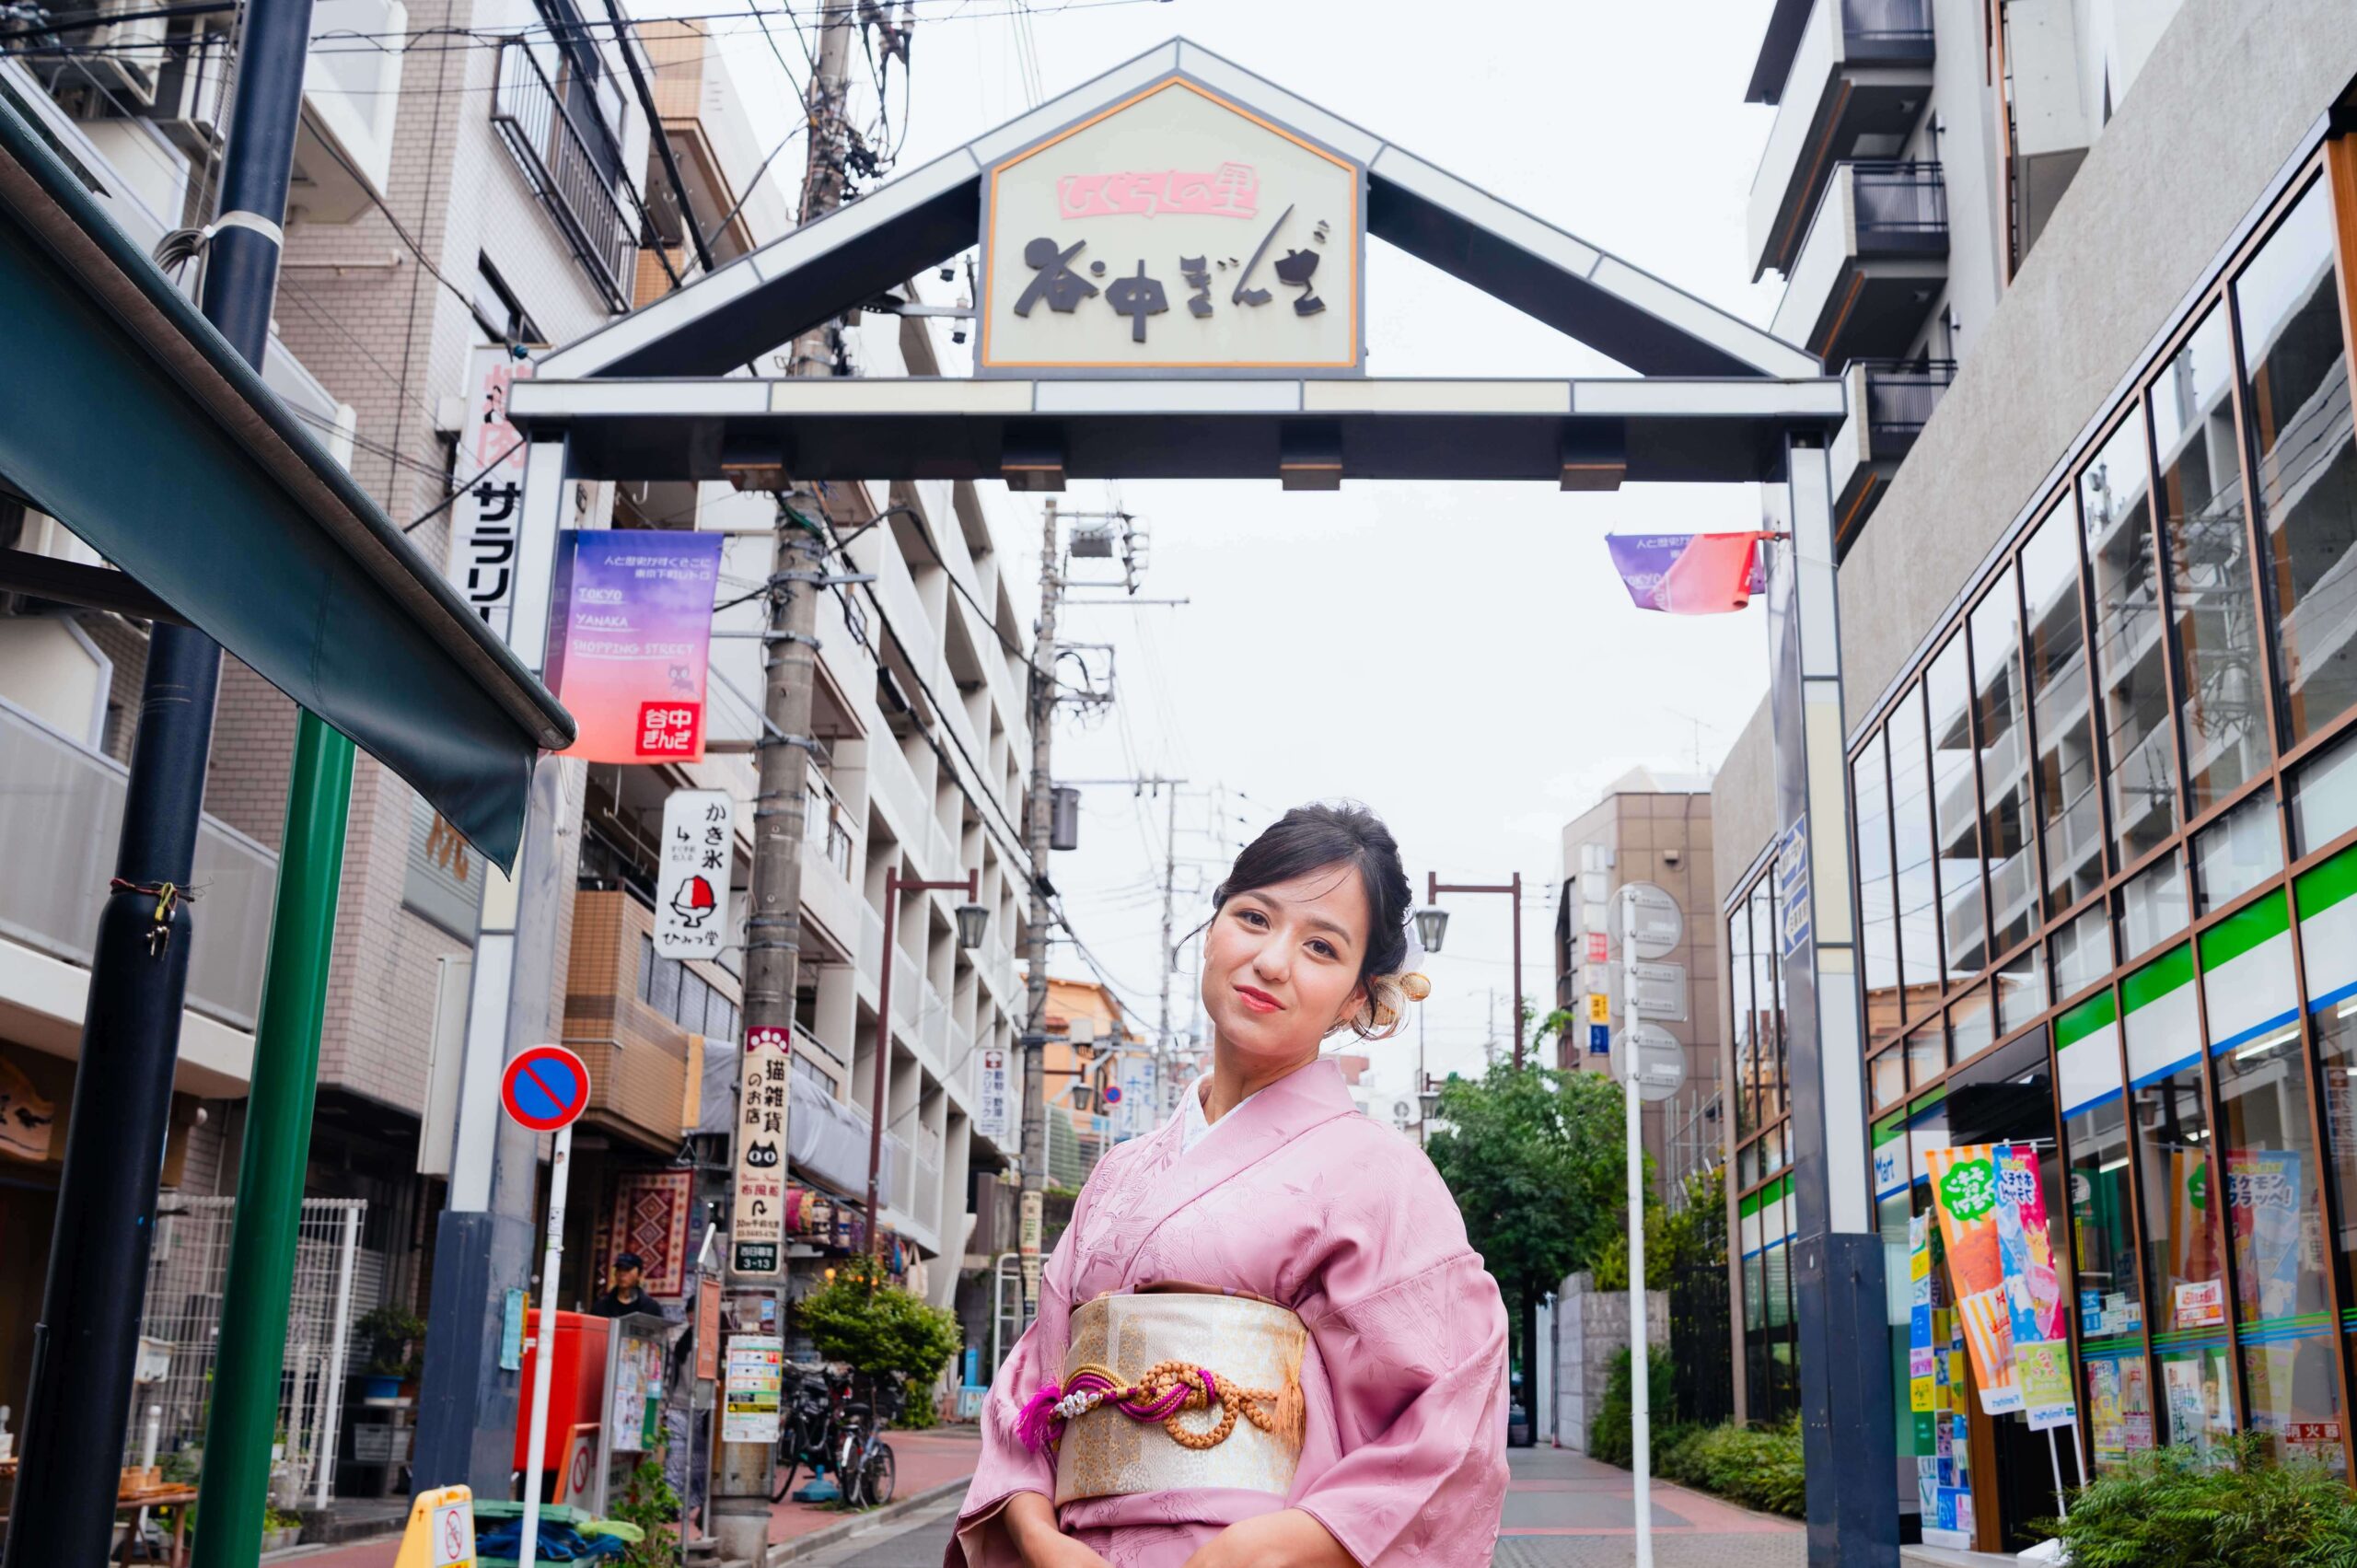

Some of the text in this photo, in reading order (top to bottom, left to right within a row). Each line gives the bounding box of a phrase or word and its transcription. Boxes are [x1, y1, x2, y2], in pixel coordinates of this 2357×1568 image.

[1061, 162, 1259, 219] ひぐらしの里
[578, 588, 623, 601] TOKYO
[575, 613, 629, 627] YANAKA
[573, 640, 695, 656] SHOPPING STREET
[645, 709, 691, 729] 谷中
[642, 729, 691, 749] ぎんざ
[702, 803, 726, 870] かき氷
[663, 930, 719, 947] ひみつ堂
[745, 1073, 762, 1125] のお店
[763, 1059, 785, 1133] 猫雑貨
[743, 1258, 771, 1269] 3-13
[2287, 1424, 2340, 1437] 消火器
